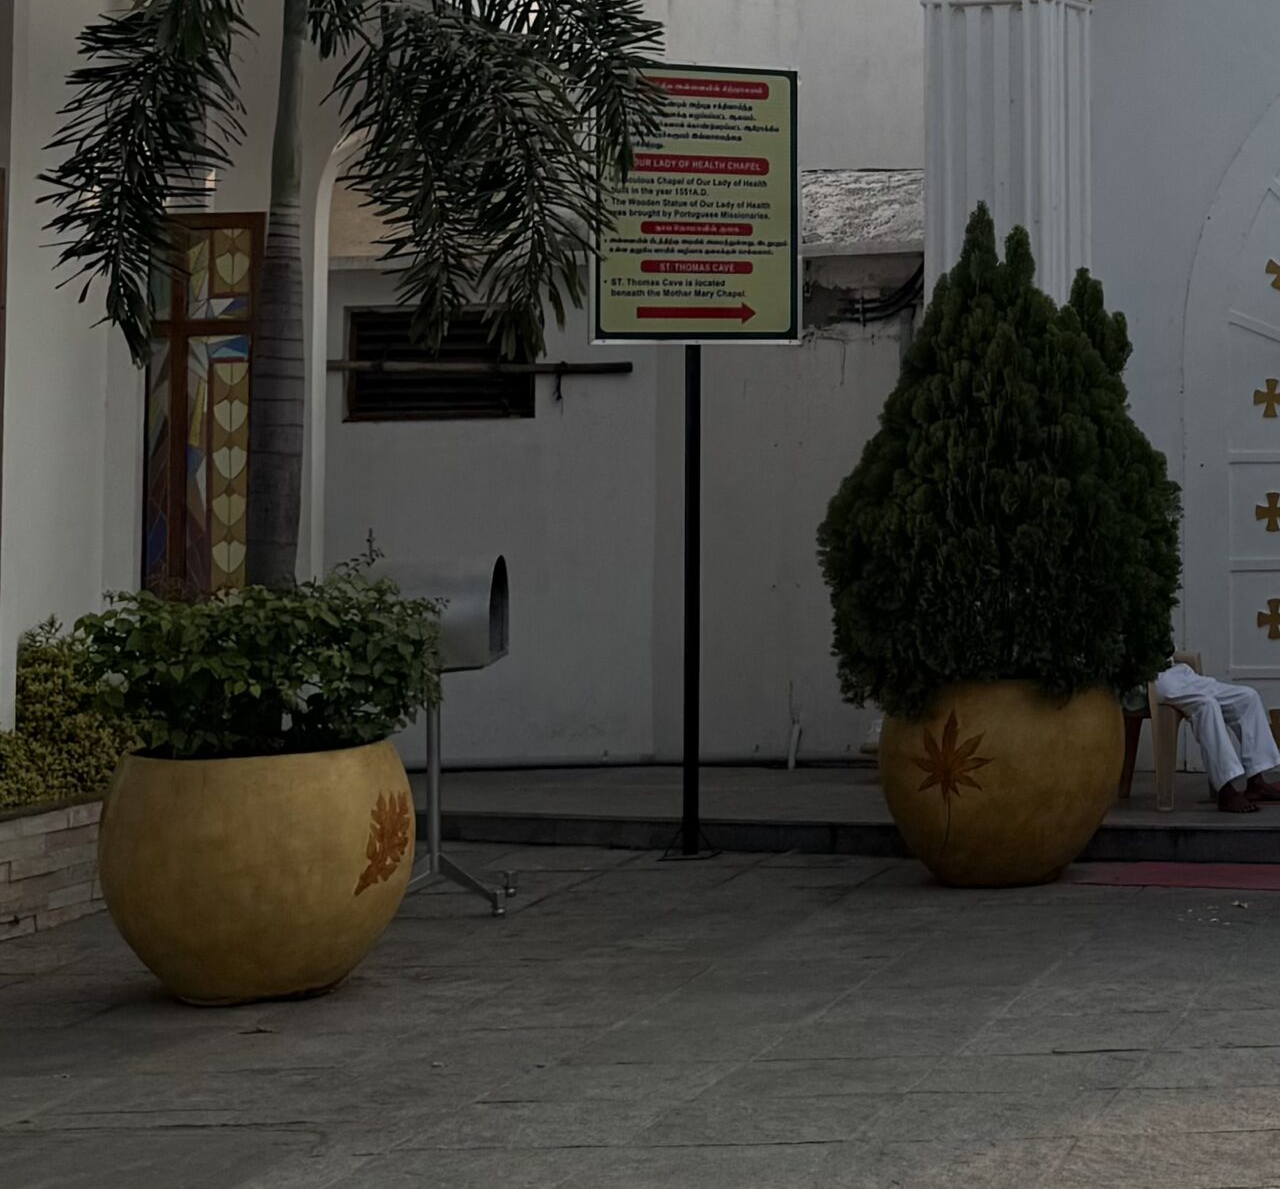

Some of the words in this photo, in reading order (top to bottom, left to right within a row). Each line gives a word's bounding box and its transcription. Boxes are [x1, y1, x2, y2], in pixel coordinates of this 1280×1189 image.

[653, 159, 675, 168] LADY
[678, 160, 690, 168] OF
[692, 160, 725, 170] HEALTH
[727, 162, 761, 171] CHAPEL
[657, 176, 684, 185] Chapel
[687, 177, 694, 185] of
[696, 178, 711, 186] Our
[713, 178, 731, 188] Lady
[733, 179, 741, 187] of
[743, 179, 768, 187] Health
[656, 188, 672, 196] year
[612, 197, 626, 205] The
[628, 198, 660, 206] Wooden
[663, 198, 687, 207] Statue
[689, 199, 697, 207] of
[700, 200, 714, 208] Our
[716, 201, 734, 210] Lady
[737, 201, 745, 209] of
[746, 201, 770, 209] Health
[629, 209, 660, 218] brought
[662, 210, 671, 218] by
[674, 210, 720, 219] Portuguese
[721, 211, 770, 220] Missionaries.
[675, 263, 710, 272] THOMAS
[712, 263, 735, 272] CAVE
[627, 278, 660, 286] Thomas
[662, 278, 683, 286] Cave
[695, 279, 725, 287] located
[611, 289, 645, 297] beneath
[647, 289, 660, 297] the
[694, 290, 714, 299] Mary
